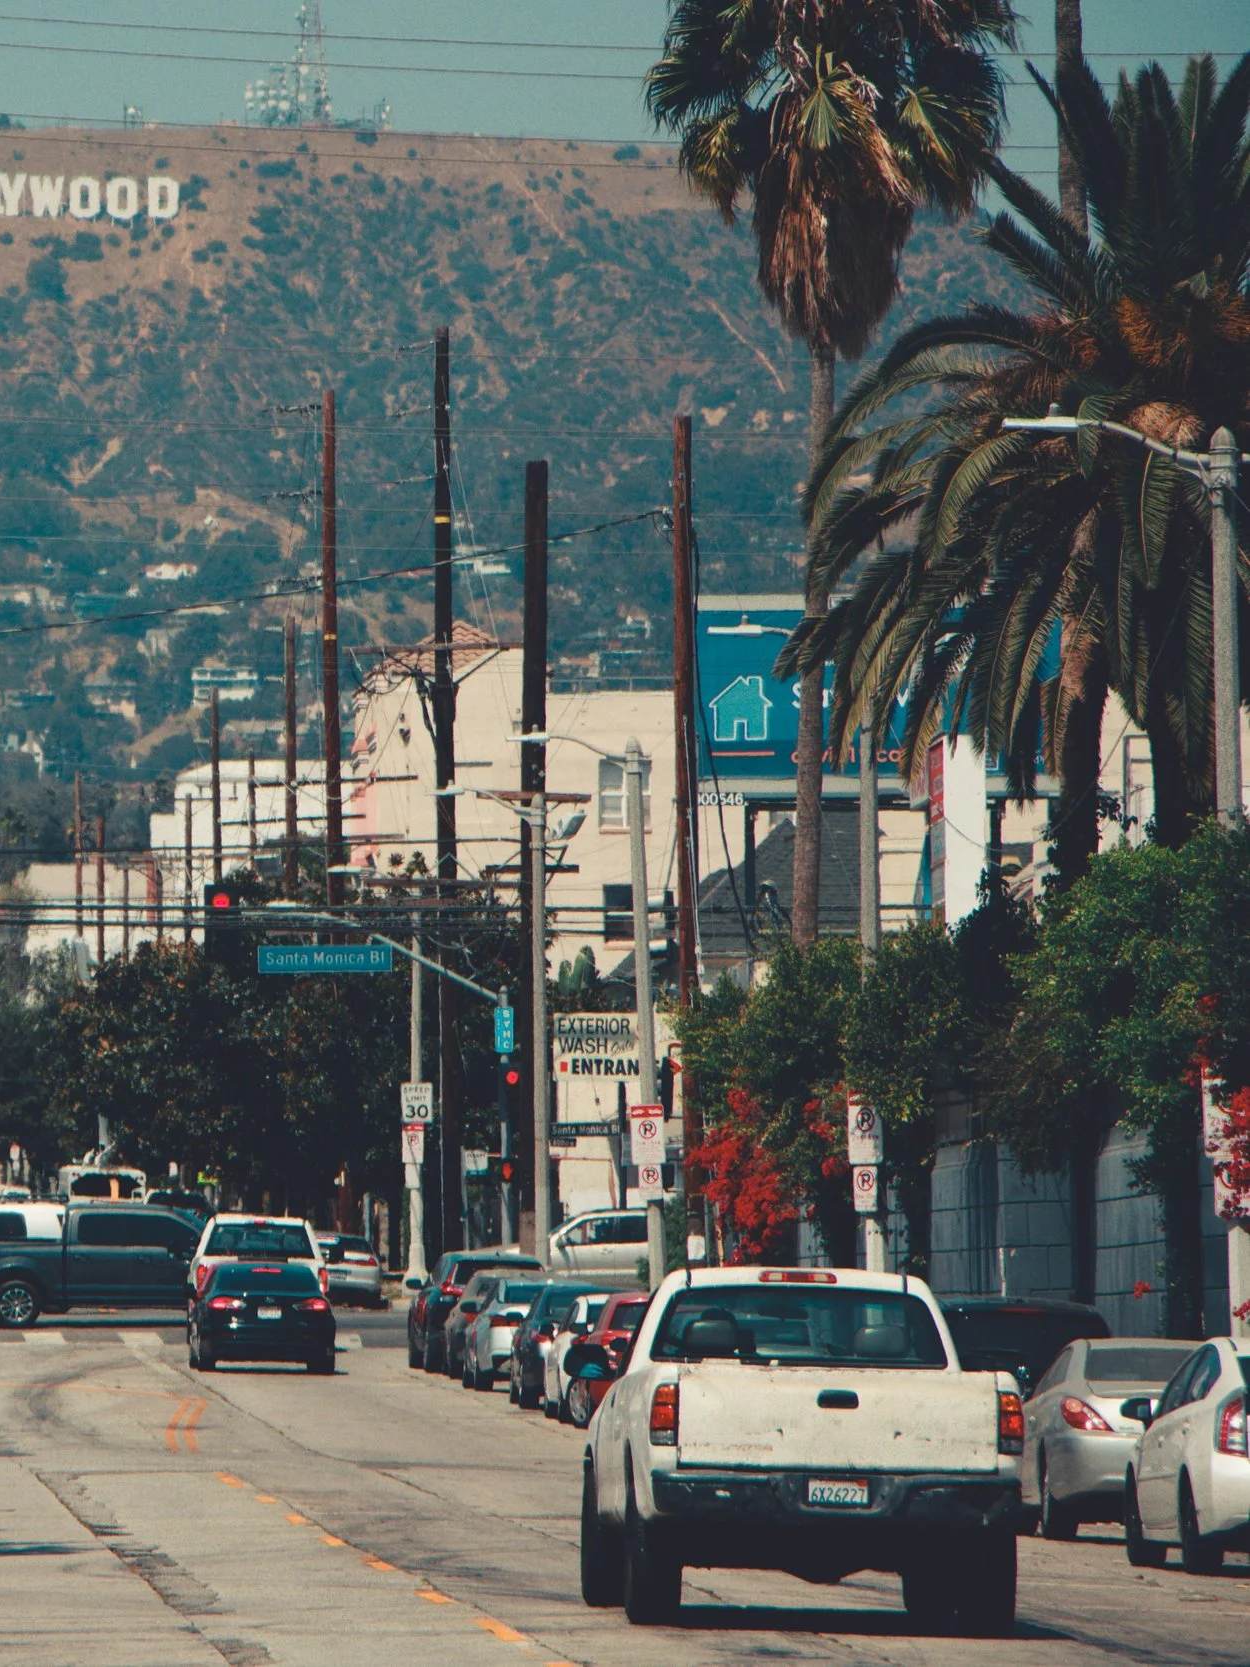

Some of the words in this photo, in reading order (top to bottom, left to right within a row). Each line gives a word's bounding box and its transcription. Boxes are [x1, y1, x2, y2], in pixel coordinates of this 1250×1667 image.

[266, 952, 308, 965] Santa
[313, 951, 365, 965] Monica
[370, 950, 385, 964] Bl
[557, 1018, 630, 1035] EXTERIOR
[559, 1038, 608, 1054] WASH
[571, 1058, 640, 1076] ENTRAN
[404, 1086, 430, 1094] SPEED
[405, 1104, 429, 1118] 30
[579, 1125, 608, 1135] Monica
